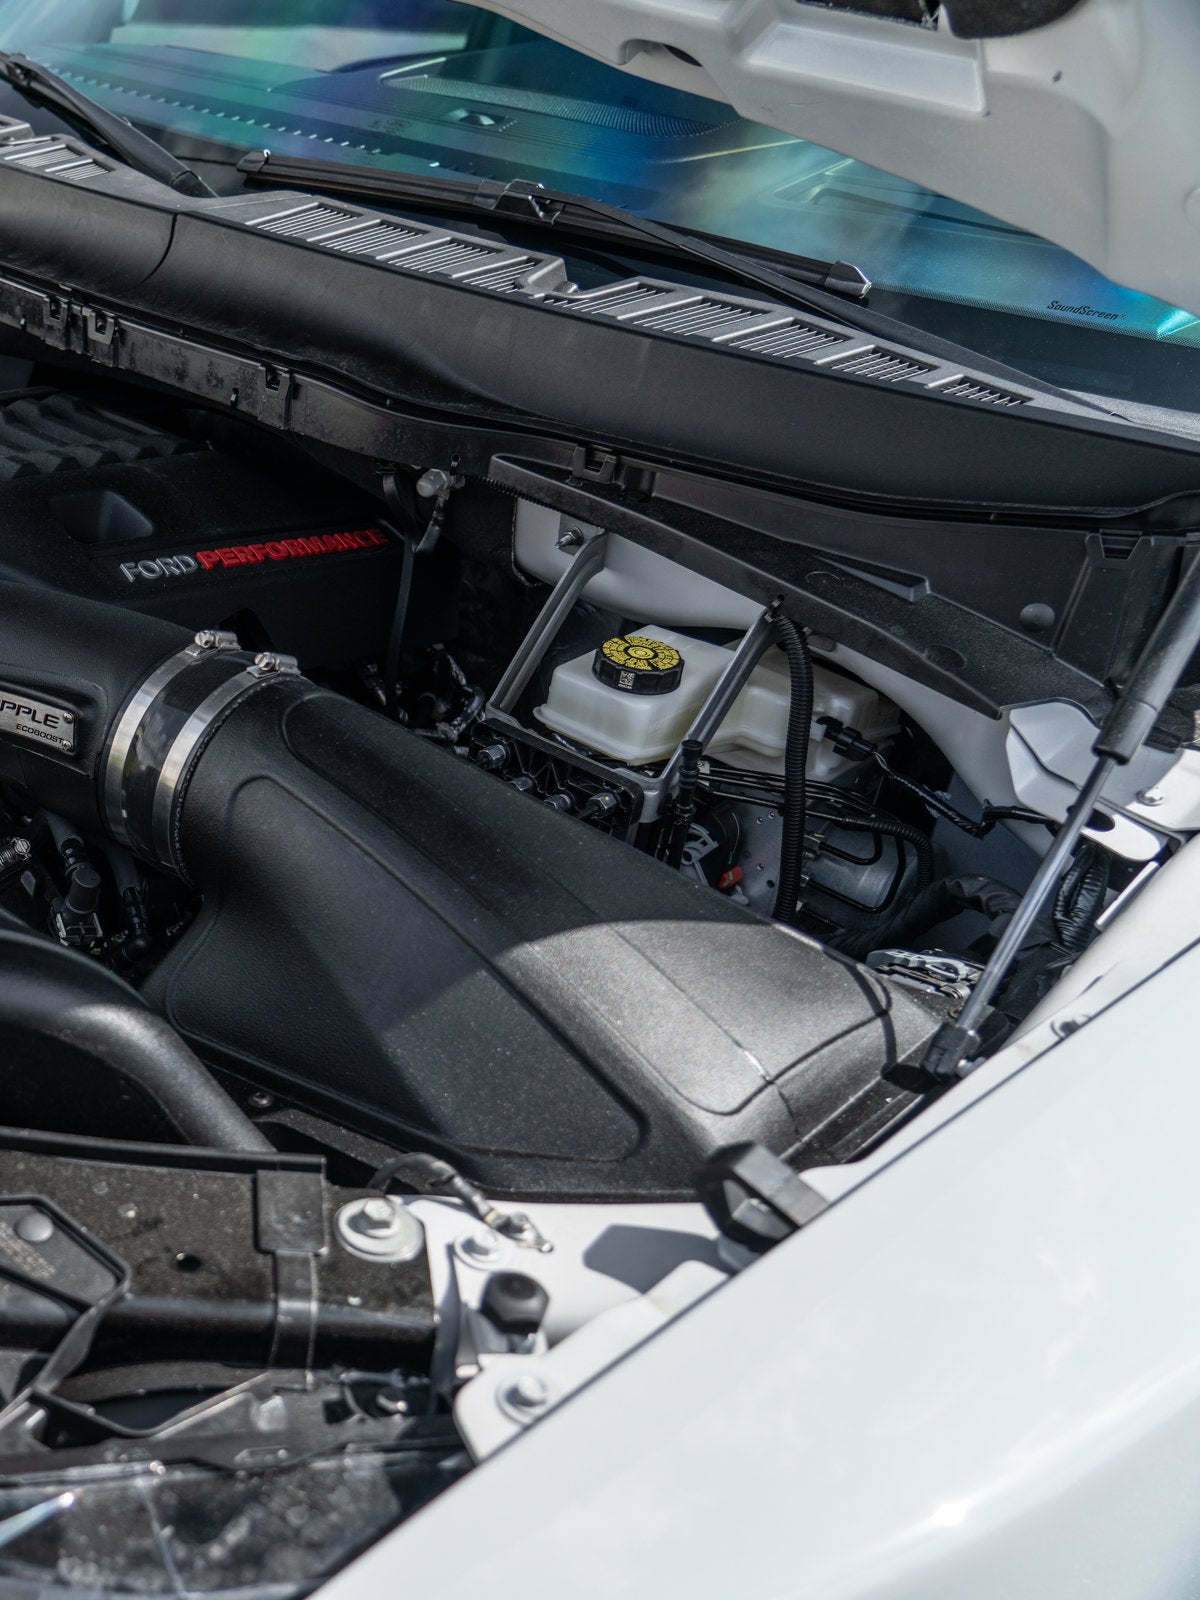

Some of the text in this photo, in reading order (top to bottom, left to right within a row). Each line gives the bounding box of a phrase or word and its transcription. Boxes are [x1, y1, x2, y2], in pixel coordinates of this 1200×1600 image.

[120, 529, 390, 582] FORD PERFORMANCE
[16, 723, 63, 743] ECOBOOST
